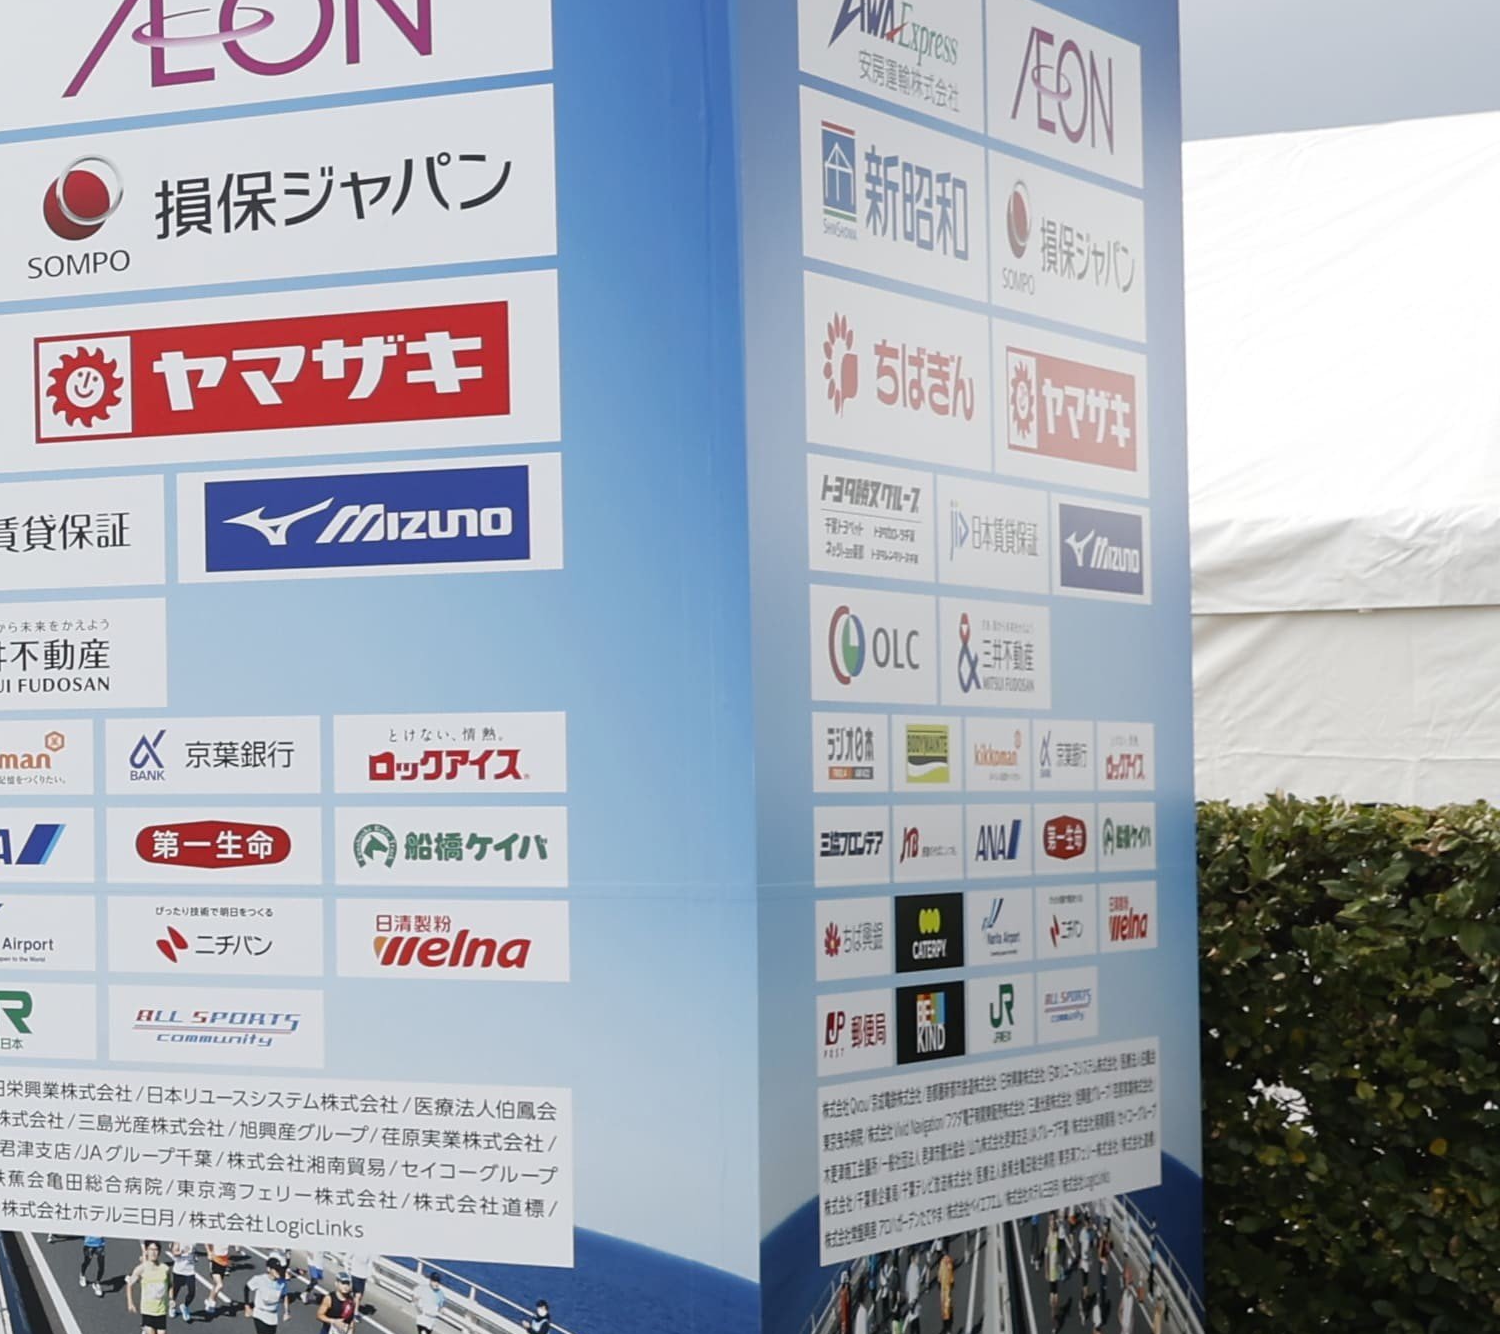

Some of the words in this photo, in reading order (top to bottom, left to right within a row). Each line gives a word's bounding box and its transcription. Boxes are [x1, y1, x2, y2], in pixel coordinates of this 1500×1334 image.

[898, 2, 958, 66] Express
[155, 148, 512, 241] 損保ジャパン
[864, 144, 968, 261] 新昭和
[27, 247, 131, 280] SOMPO
[1040, 216, 1135, 293] 損保ジャパン
[153, 326, 484, 413] ヤマザキ
[874, 339, 974, 422] ちばぎん
[1042, 378, 1131, 447] ヤマザキ
[872, 627, 919, 669] OLC
[16, 675, 111, 694] FUDOSAN
[184, 739, 295, 770] 京葉銀行
[368, 748, 523, 781] ロックアイス
[151, 829, 275, 860] 第一生命
[404, 831, 548, 861] 船橋ケイバ
[975, 825, 1007, 861] ANA
[376, 914, 452, 933] 日清製粉
[2, 937, 54, 953] Airport
[194, 934, 273, 958] ニチバン
[990, 984, 1014, 1028] JR
[157, 1033, 273, 1048] community
[917, 1024, 945, 1053] KIND
